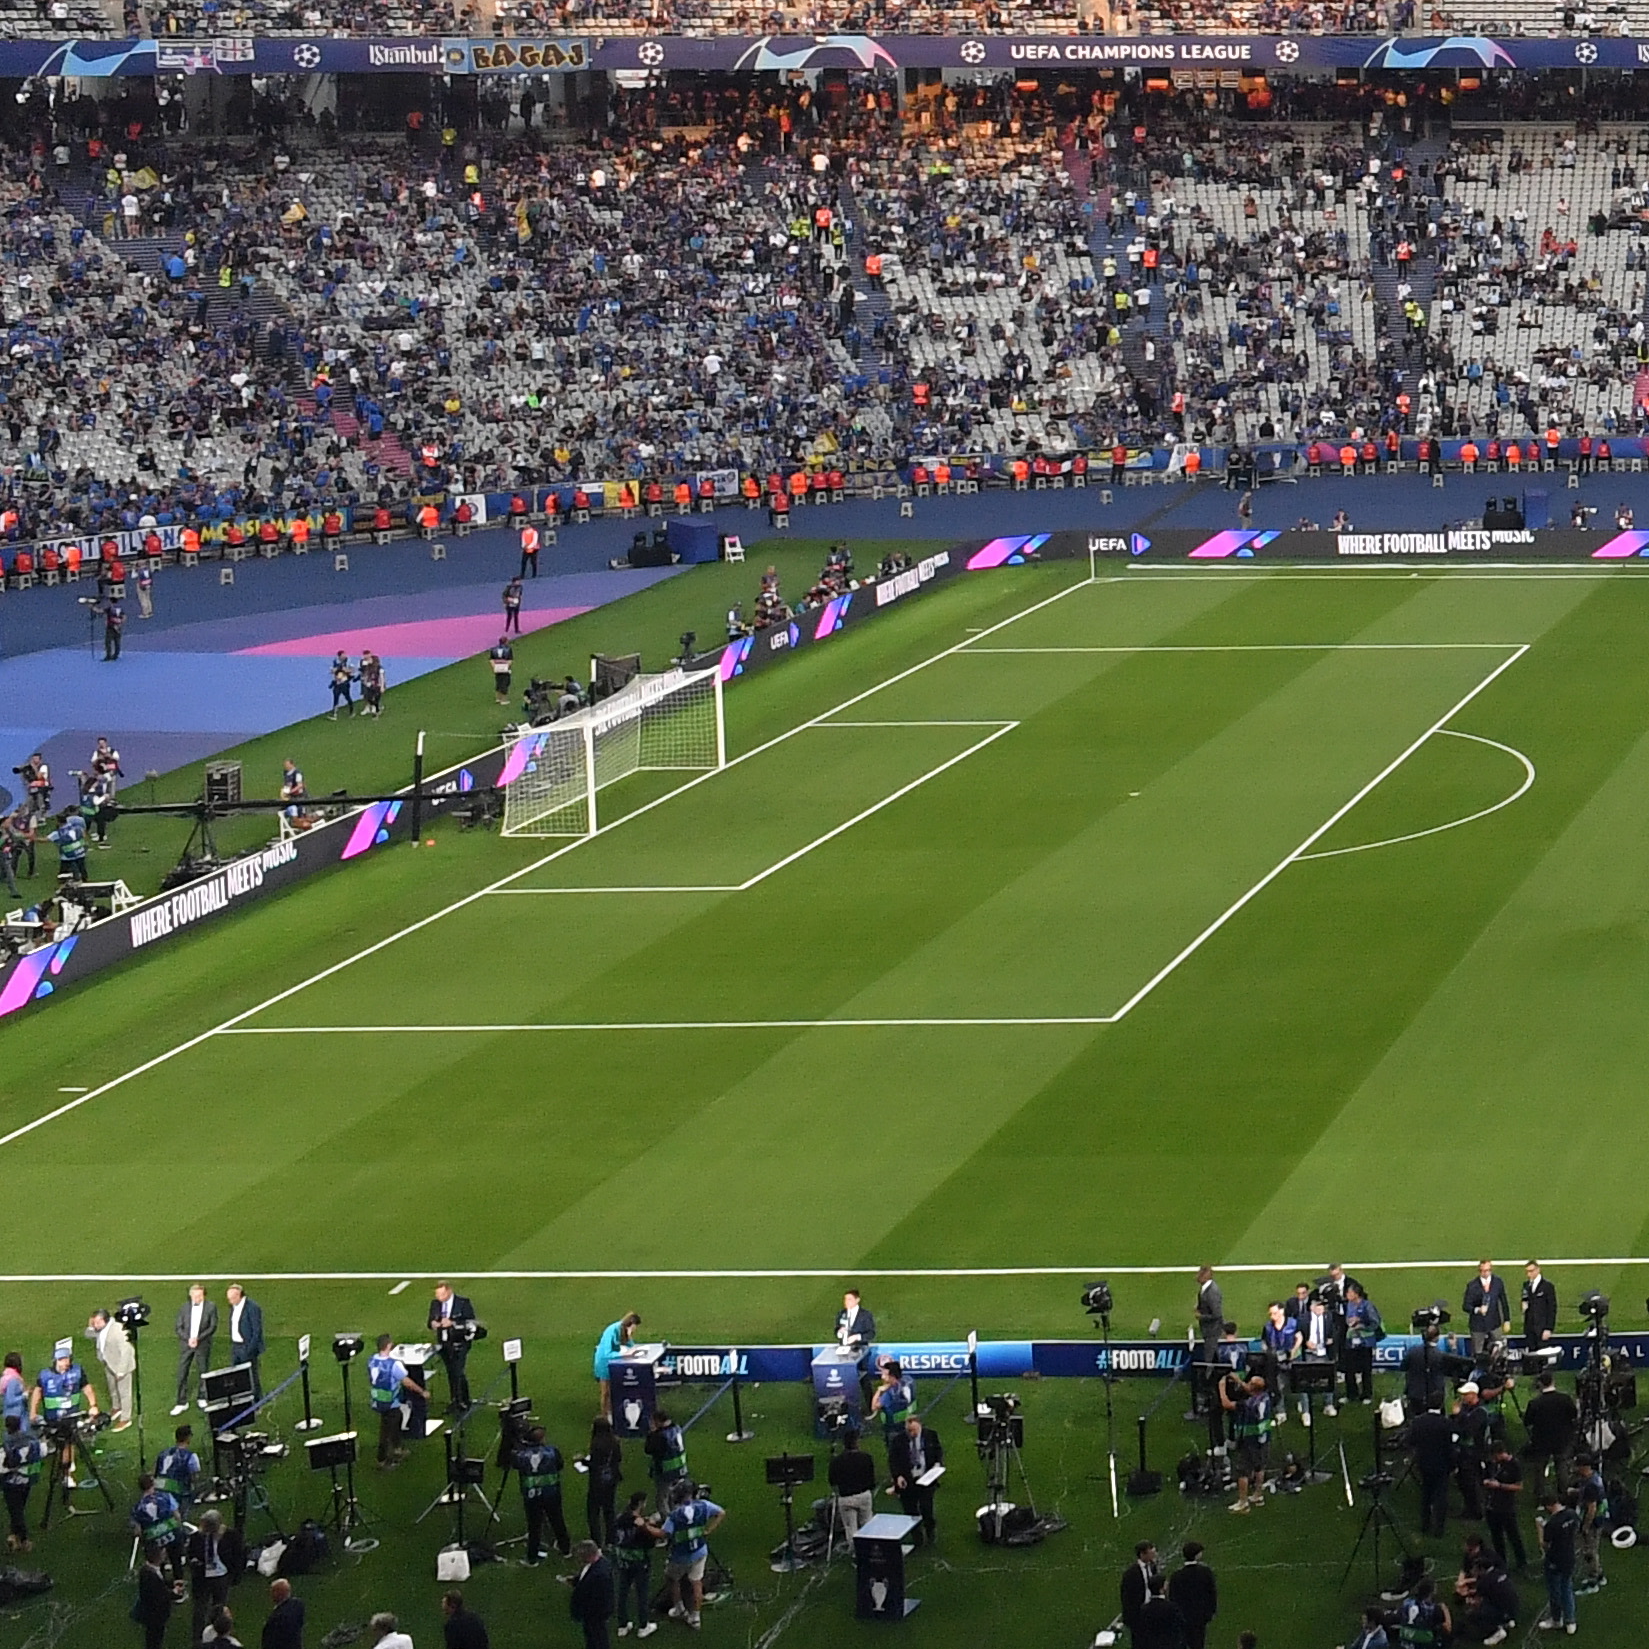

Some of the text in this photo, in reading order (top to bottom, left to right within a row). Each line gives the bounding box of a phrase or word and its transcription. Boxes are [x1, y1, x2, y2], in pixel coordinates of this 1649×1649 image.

[370, 43, 444, 65] Istanbul
[1011, 45, 1250, 59] UEFA CHAMPIONS LEAGUE
[1089, 538, 1127, 550] UEFA
[1338, 535, 1382, 554] WHERE
[1384, 534, 1447, 553] FOOTBALL
[1448, 531, 1490, 550] MEETS
[770, 630, 789, 650] UEFA
[130, 900, 173, 948] WHERE
[171, 876, 229, 928] FOOTBALL
[227, 856, 264, 899] MEETS
[1095, 1349, 1183, 1370] #FOOTBALL
[1572, 1344, 1645, 1360] FAL
[661, 1354, 749, 1377] #FOOTBAL
[899, 1354, 970, 1371] RESPECT
